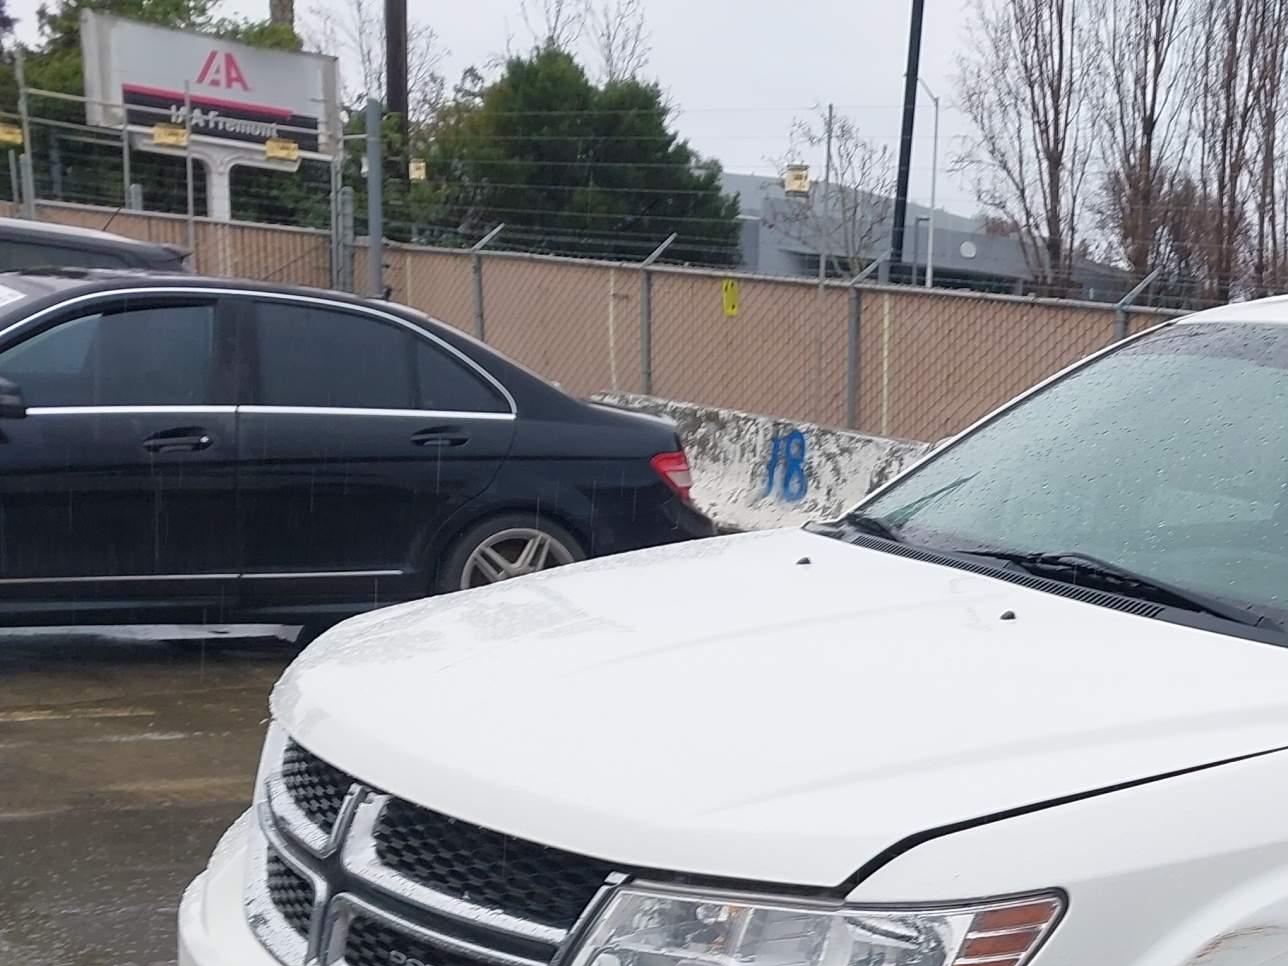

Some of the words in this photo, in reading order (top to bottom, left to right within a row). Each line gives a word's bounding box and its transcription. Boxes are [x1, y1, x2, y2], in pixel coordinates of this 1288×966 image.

[196, 49, 249, 91] IAA
[206, 110, 279, 138] Fremont
[766, 429, 808, 503] 18
